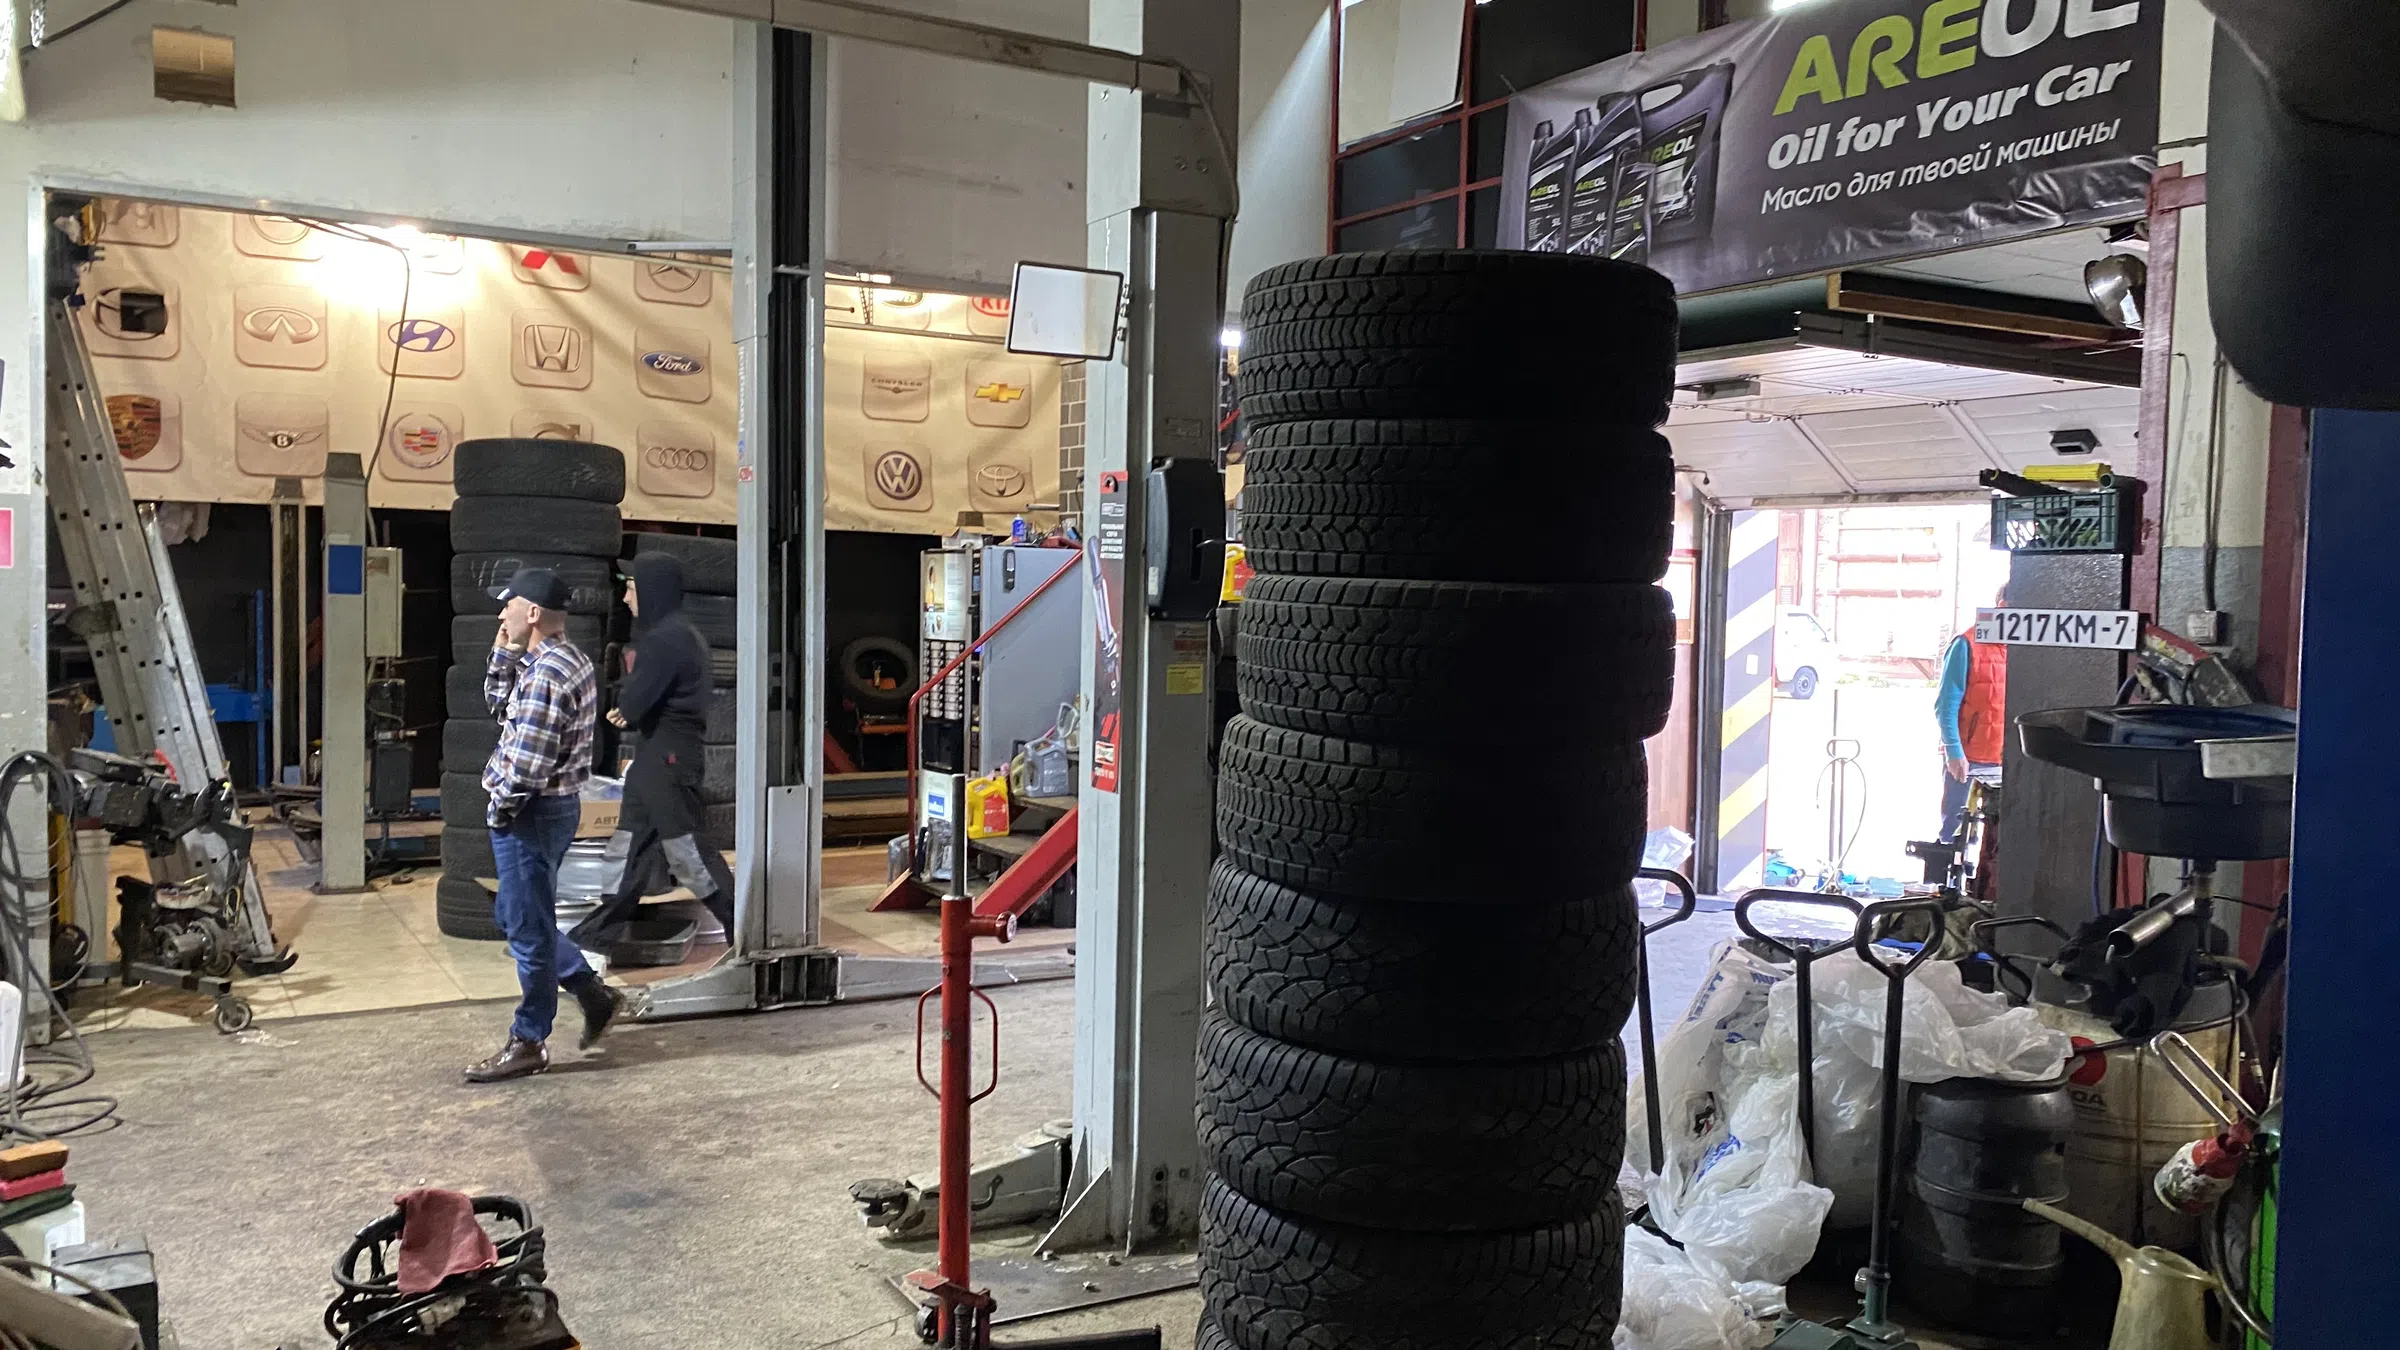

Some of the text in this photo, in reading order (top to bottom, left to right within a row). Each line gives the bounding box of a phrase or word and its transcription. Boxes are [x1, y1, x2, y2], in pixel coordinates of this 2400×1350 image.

[1772, 0, 2140, 116] AREOL
[1767, 60, 2133, 170] Oil for Your Car
[1652, 135, 1696, 164] REOL
[1761, 118, 2121, 214] Масло для твоей машины
[1530, 183, 1561, 198] AREOL
[1576, 176, 1607, 192] AREOL
[653, 353, 693, 372] Ford
[1976, 628, 1989, 640] BY
[1995, 612, 2051, 642] 1217
